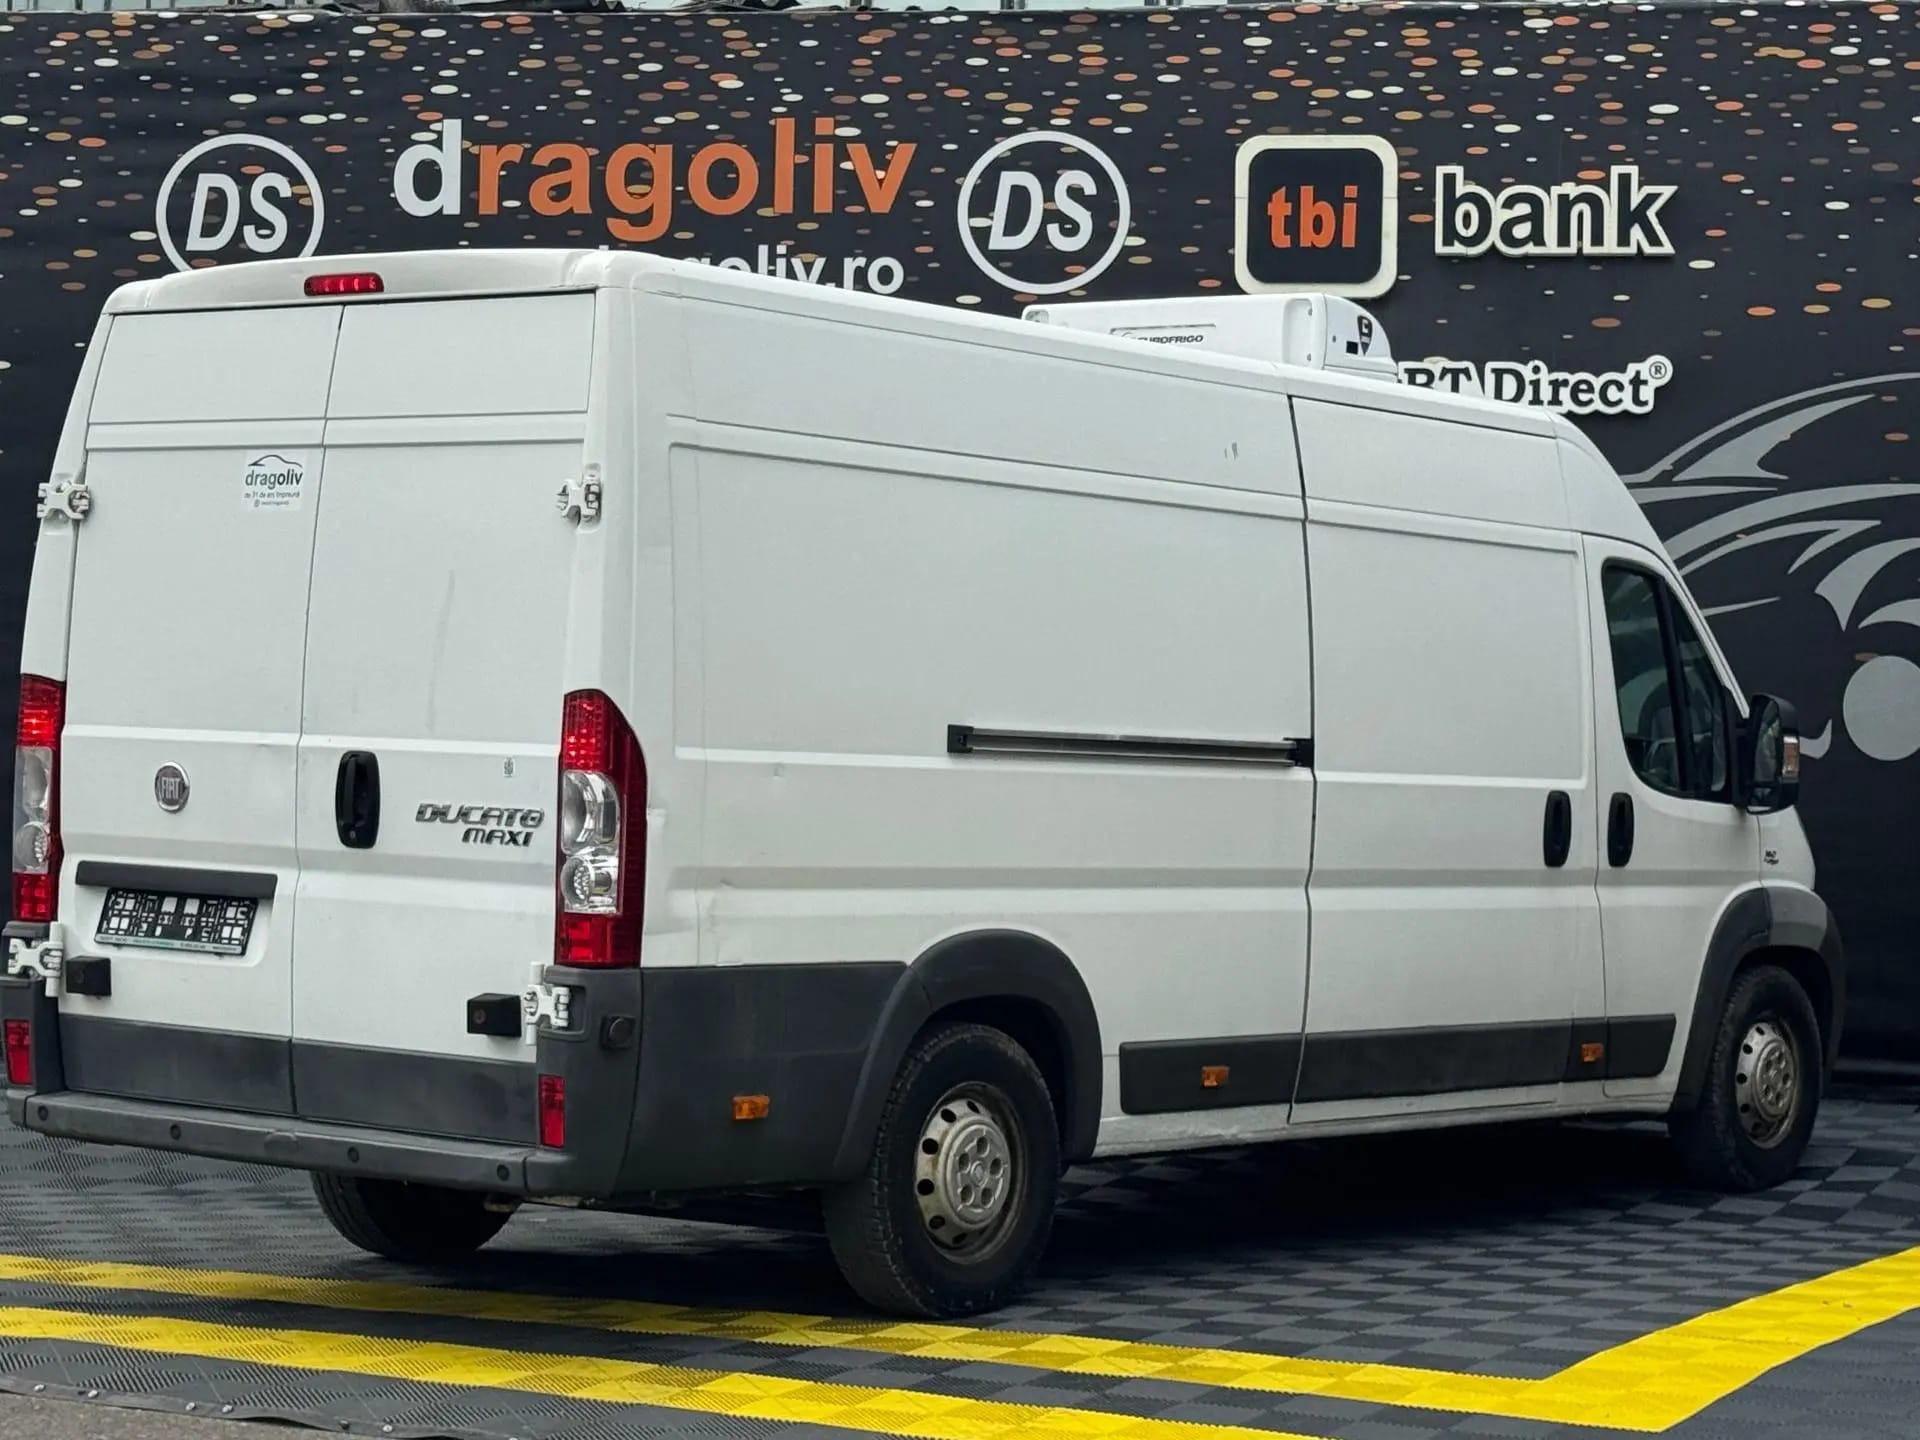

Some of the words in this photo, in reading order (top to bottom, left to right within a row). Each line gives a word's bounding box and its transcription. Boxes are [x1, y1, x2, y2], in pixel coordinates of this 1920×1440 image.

[394, 117, 916, 242] dragoliv
[186, 173, 292, 253] DS
[988, 170, 1097, 252] DS
[1267, 185, 1358, 248] tbi
[1435, 165, 1678, 257] bank
[245, 468, 303, 490] dragoliv
[161, 776, 181, 800] FIAT
[415, 802, 545, 828] DUCATO
[461, 827, 534, 847] MAXI
